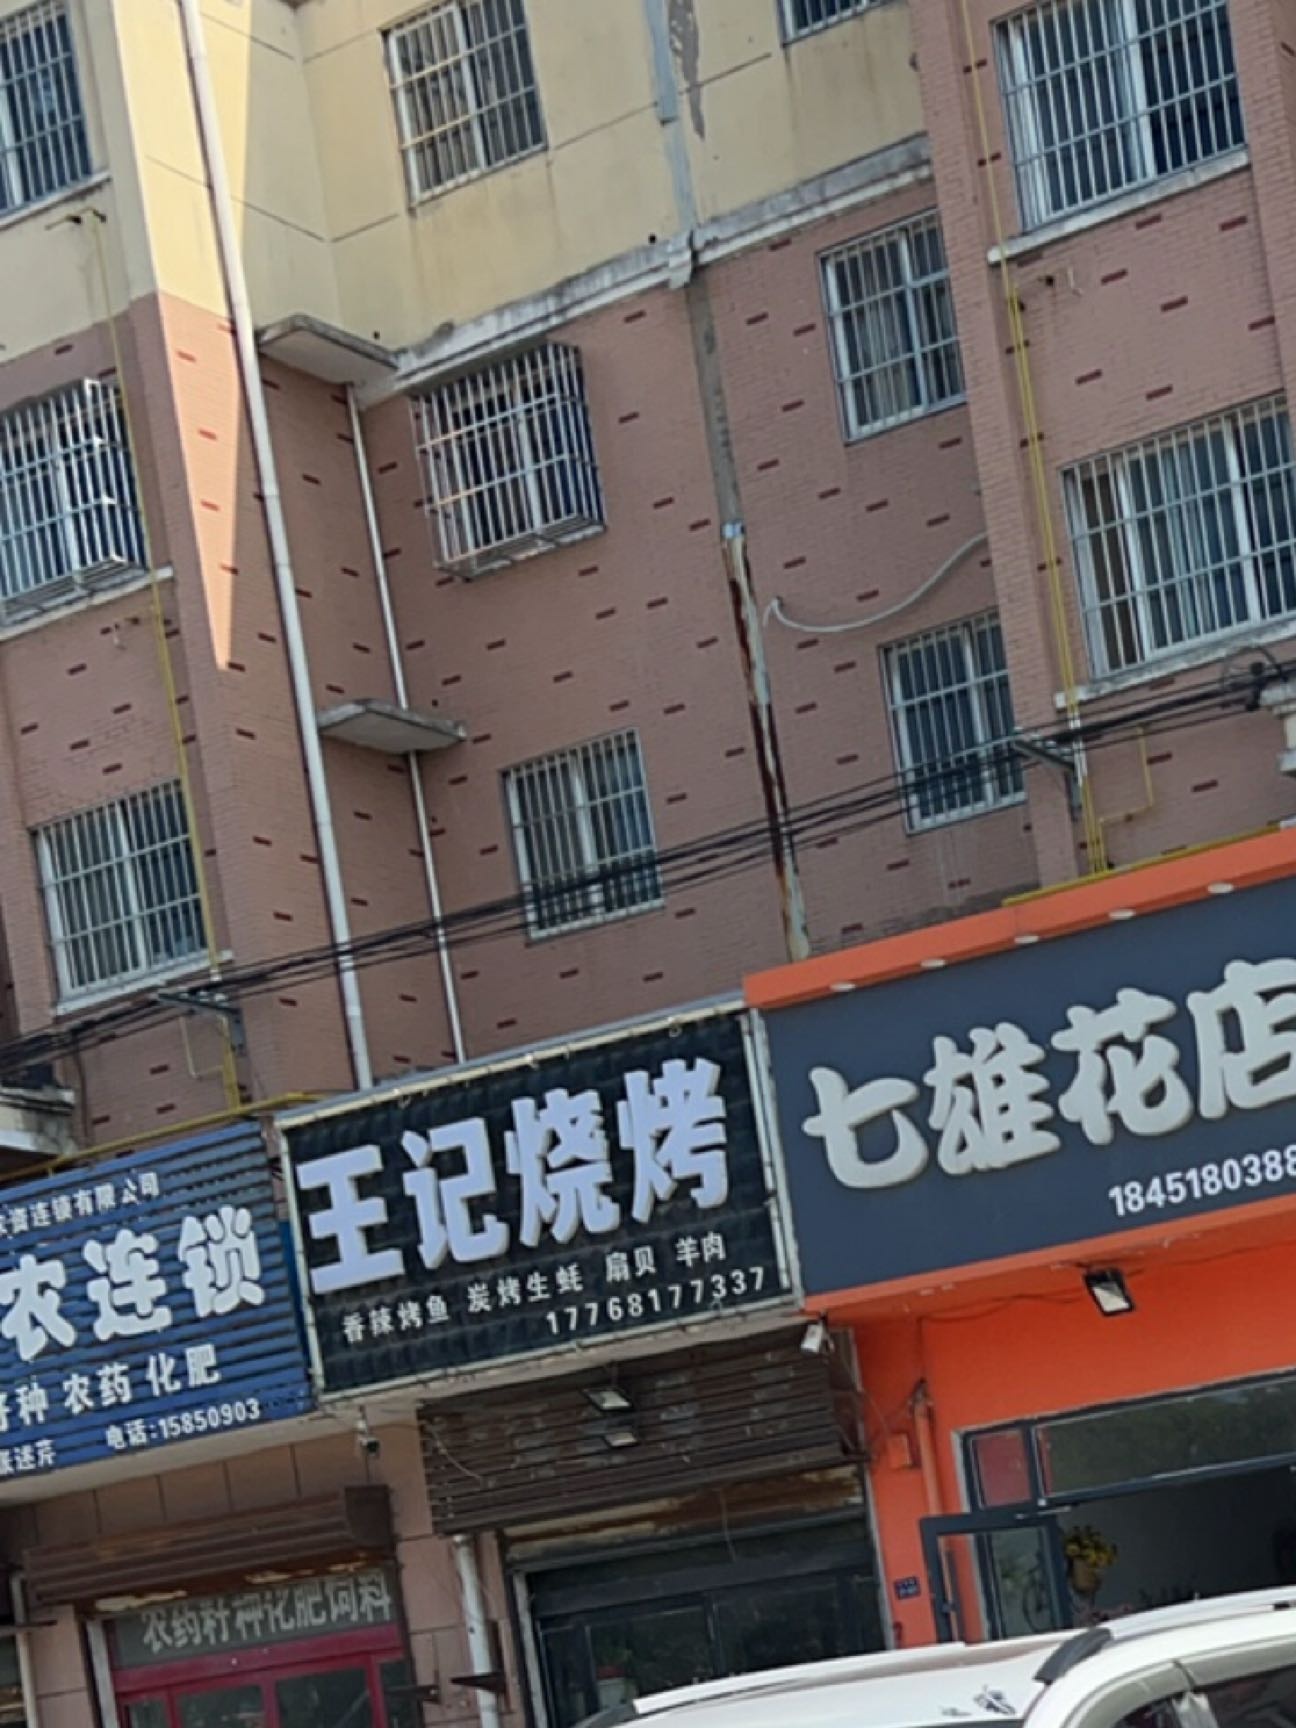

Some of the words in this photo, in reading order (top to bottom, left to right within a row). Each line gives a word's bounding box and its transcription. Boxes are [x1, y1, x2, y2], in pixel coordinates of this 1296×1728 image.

[295, 1057, 729, 1295] 王记烧烤
[0, 1205, 266, 1361] 农连锁
[343, 1295, 450, 1345] 香辣烤鱼
[467, 1264, 583, 1314] 炭烤生蚝
[605, 1244, 657, 1284] 扇贝
[675, 1231, 726, 1269] 羊肉
[545, 1266, 766, 1336] 17768177337
[63, 1362, 133, 1414] 农药
[146, 1343, 222, 1397] 化肥
